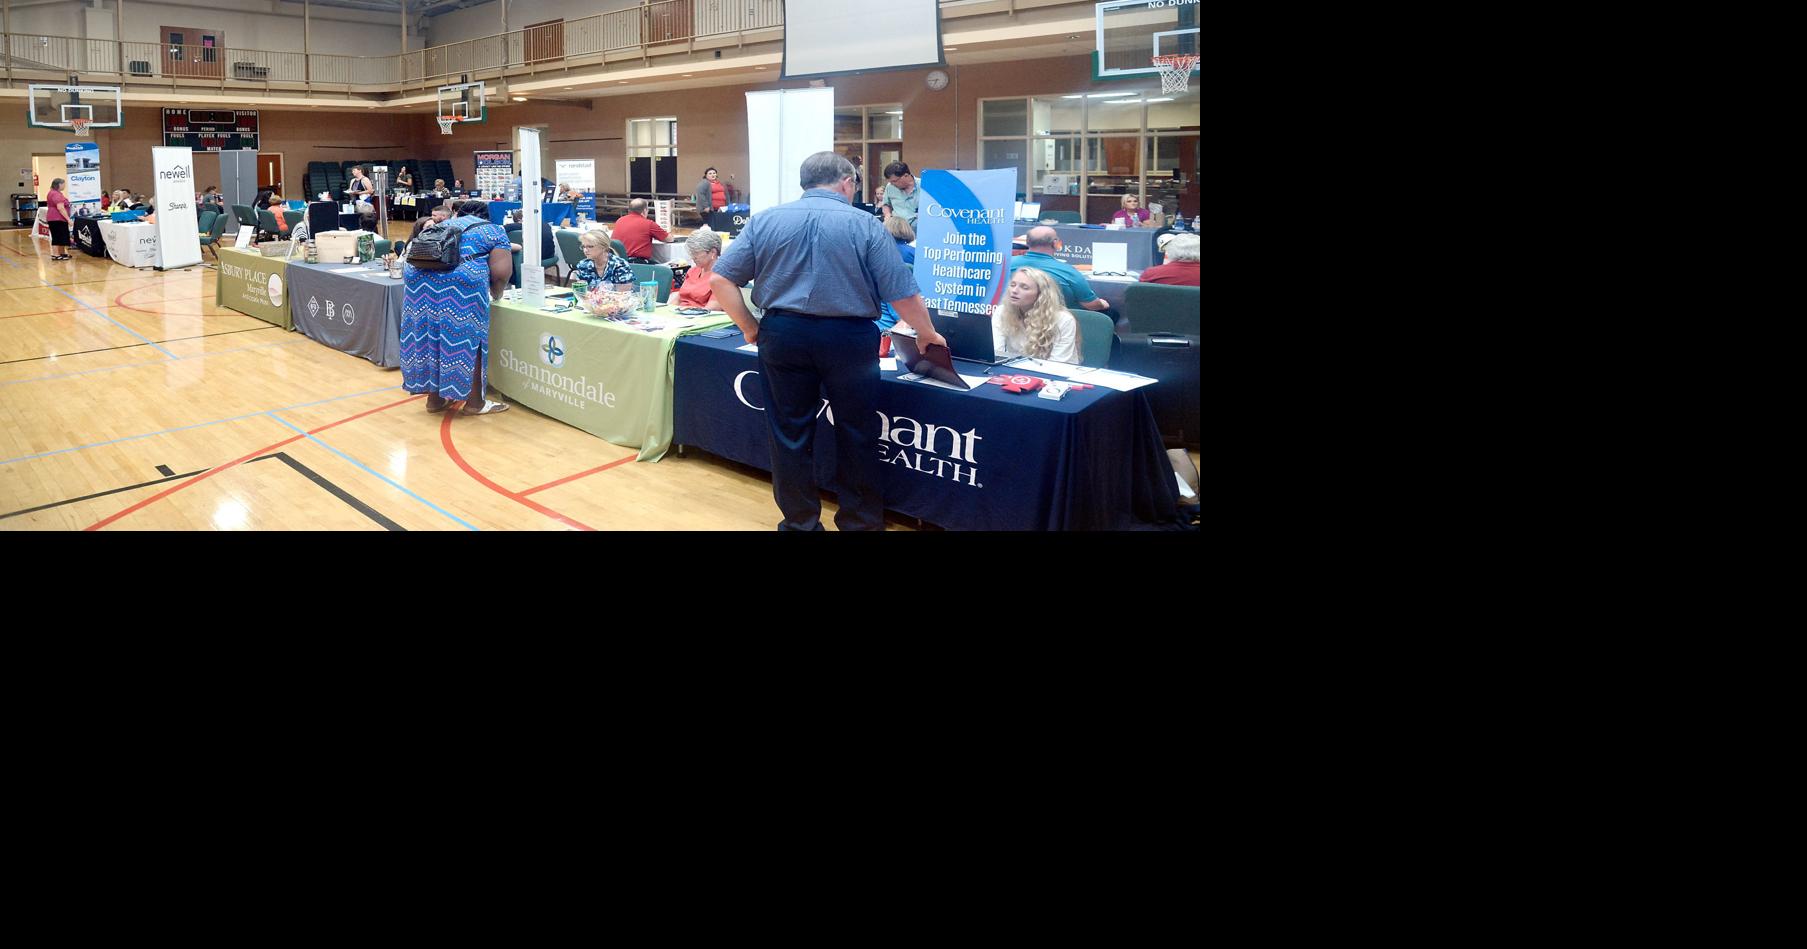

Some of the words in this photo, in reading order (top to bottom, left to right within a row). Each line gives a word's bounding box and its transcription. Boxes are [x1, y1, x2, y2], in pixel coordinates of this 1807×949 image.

[160, 165, 191, 179] newell
[926, 203, 1005, 219] Covenant
[943, 232, 966, 245] Join
[968, 232, 986, 246] the
[923, 246, 942, 261] Top
[943, 248, 1003, 265] Performing
[244, 268, 267, 285] PLACE
[932, 264, 992, 280] Healthcare
[246, 282, 267, 297] Maryville
[934, 281, 974, 297] System
[976, 284, 986, 297] in
[922, 296, 942, 309] ast
[499, 348, 616, 408] Shannondale
[531, 382, 585, 410] MARYVILLE
[878, 443, 978, 487] EALTH
